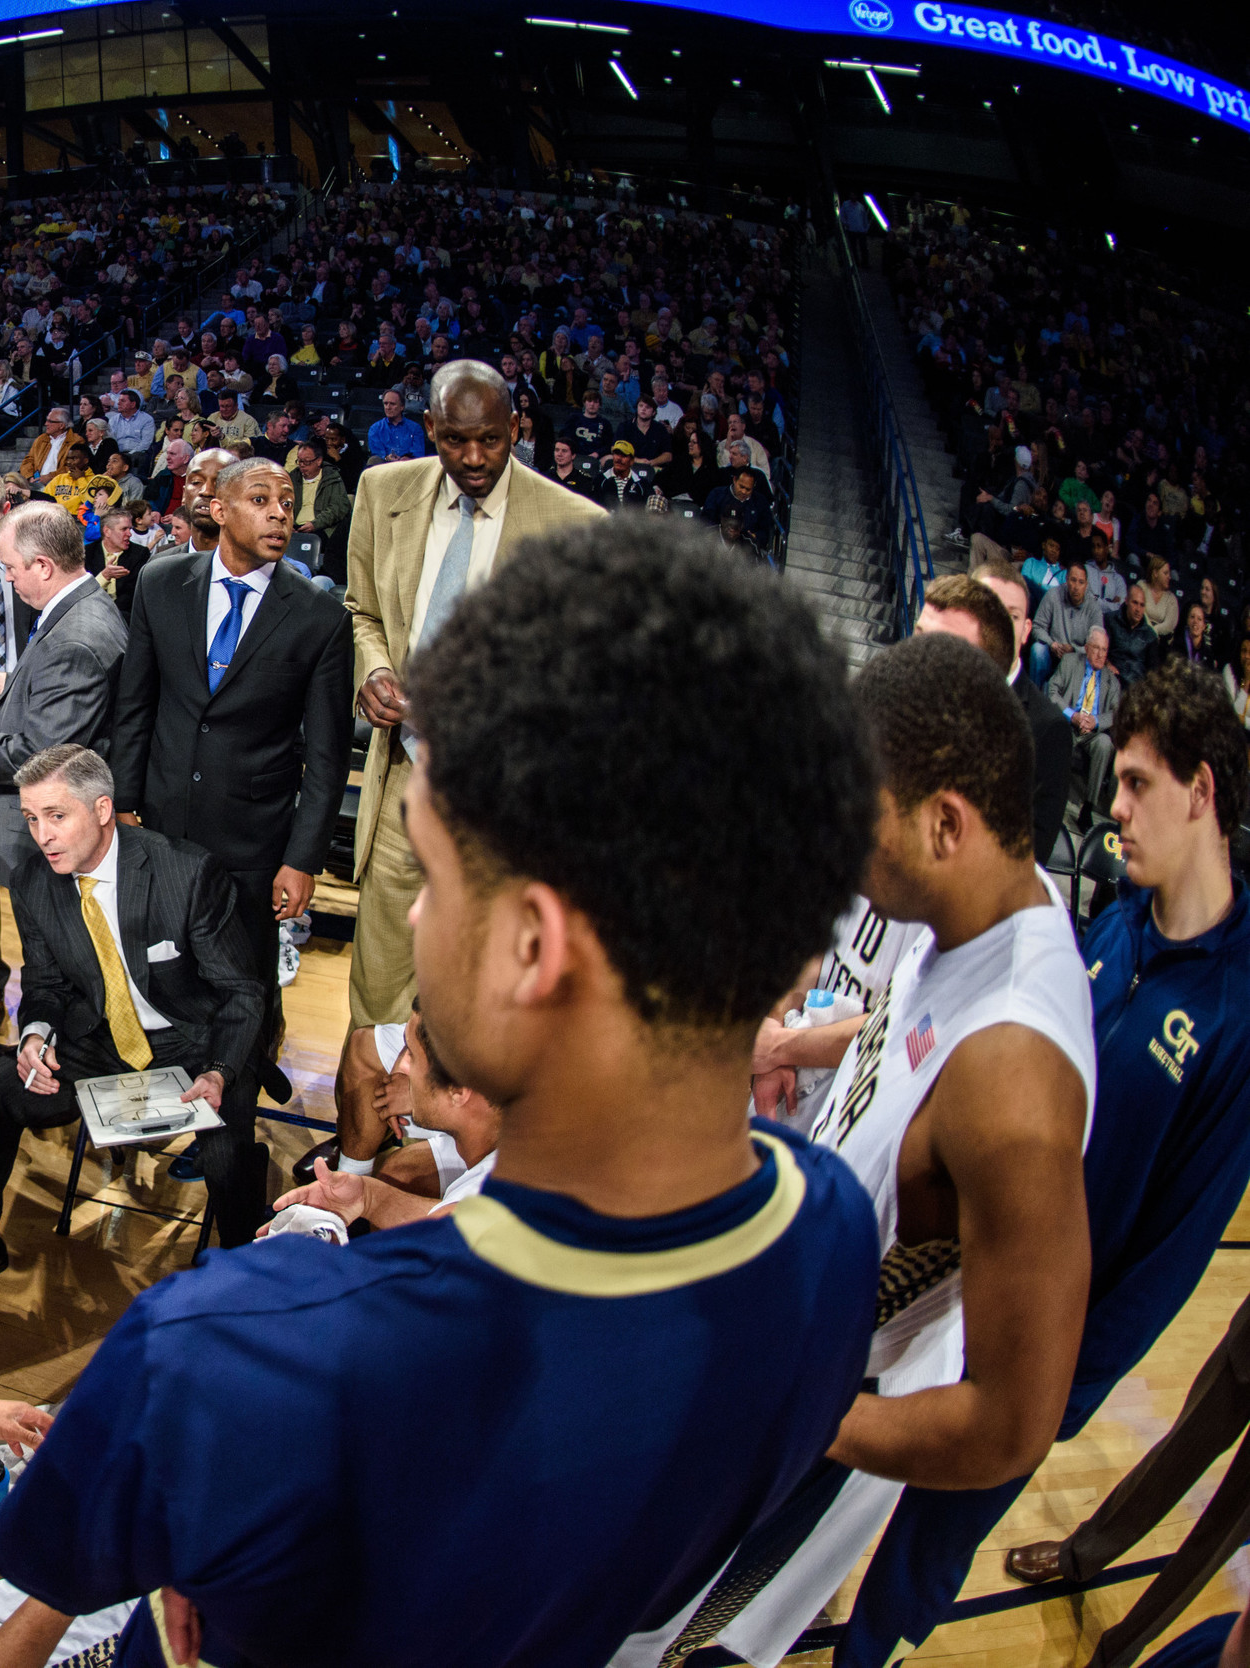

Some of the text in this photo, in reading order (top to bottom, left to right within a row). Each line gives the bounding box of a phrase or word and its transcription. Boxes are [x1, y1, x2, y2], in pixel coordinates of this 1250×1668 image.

[852, 3, 890, 27] Kroger
[914, 2, 1250, 122] Great food. Low pri
[1163, 1008, 1201, 1065] GT
